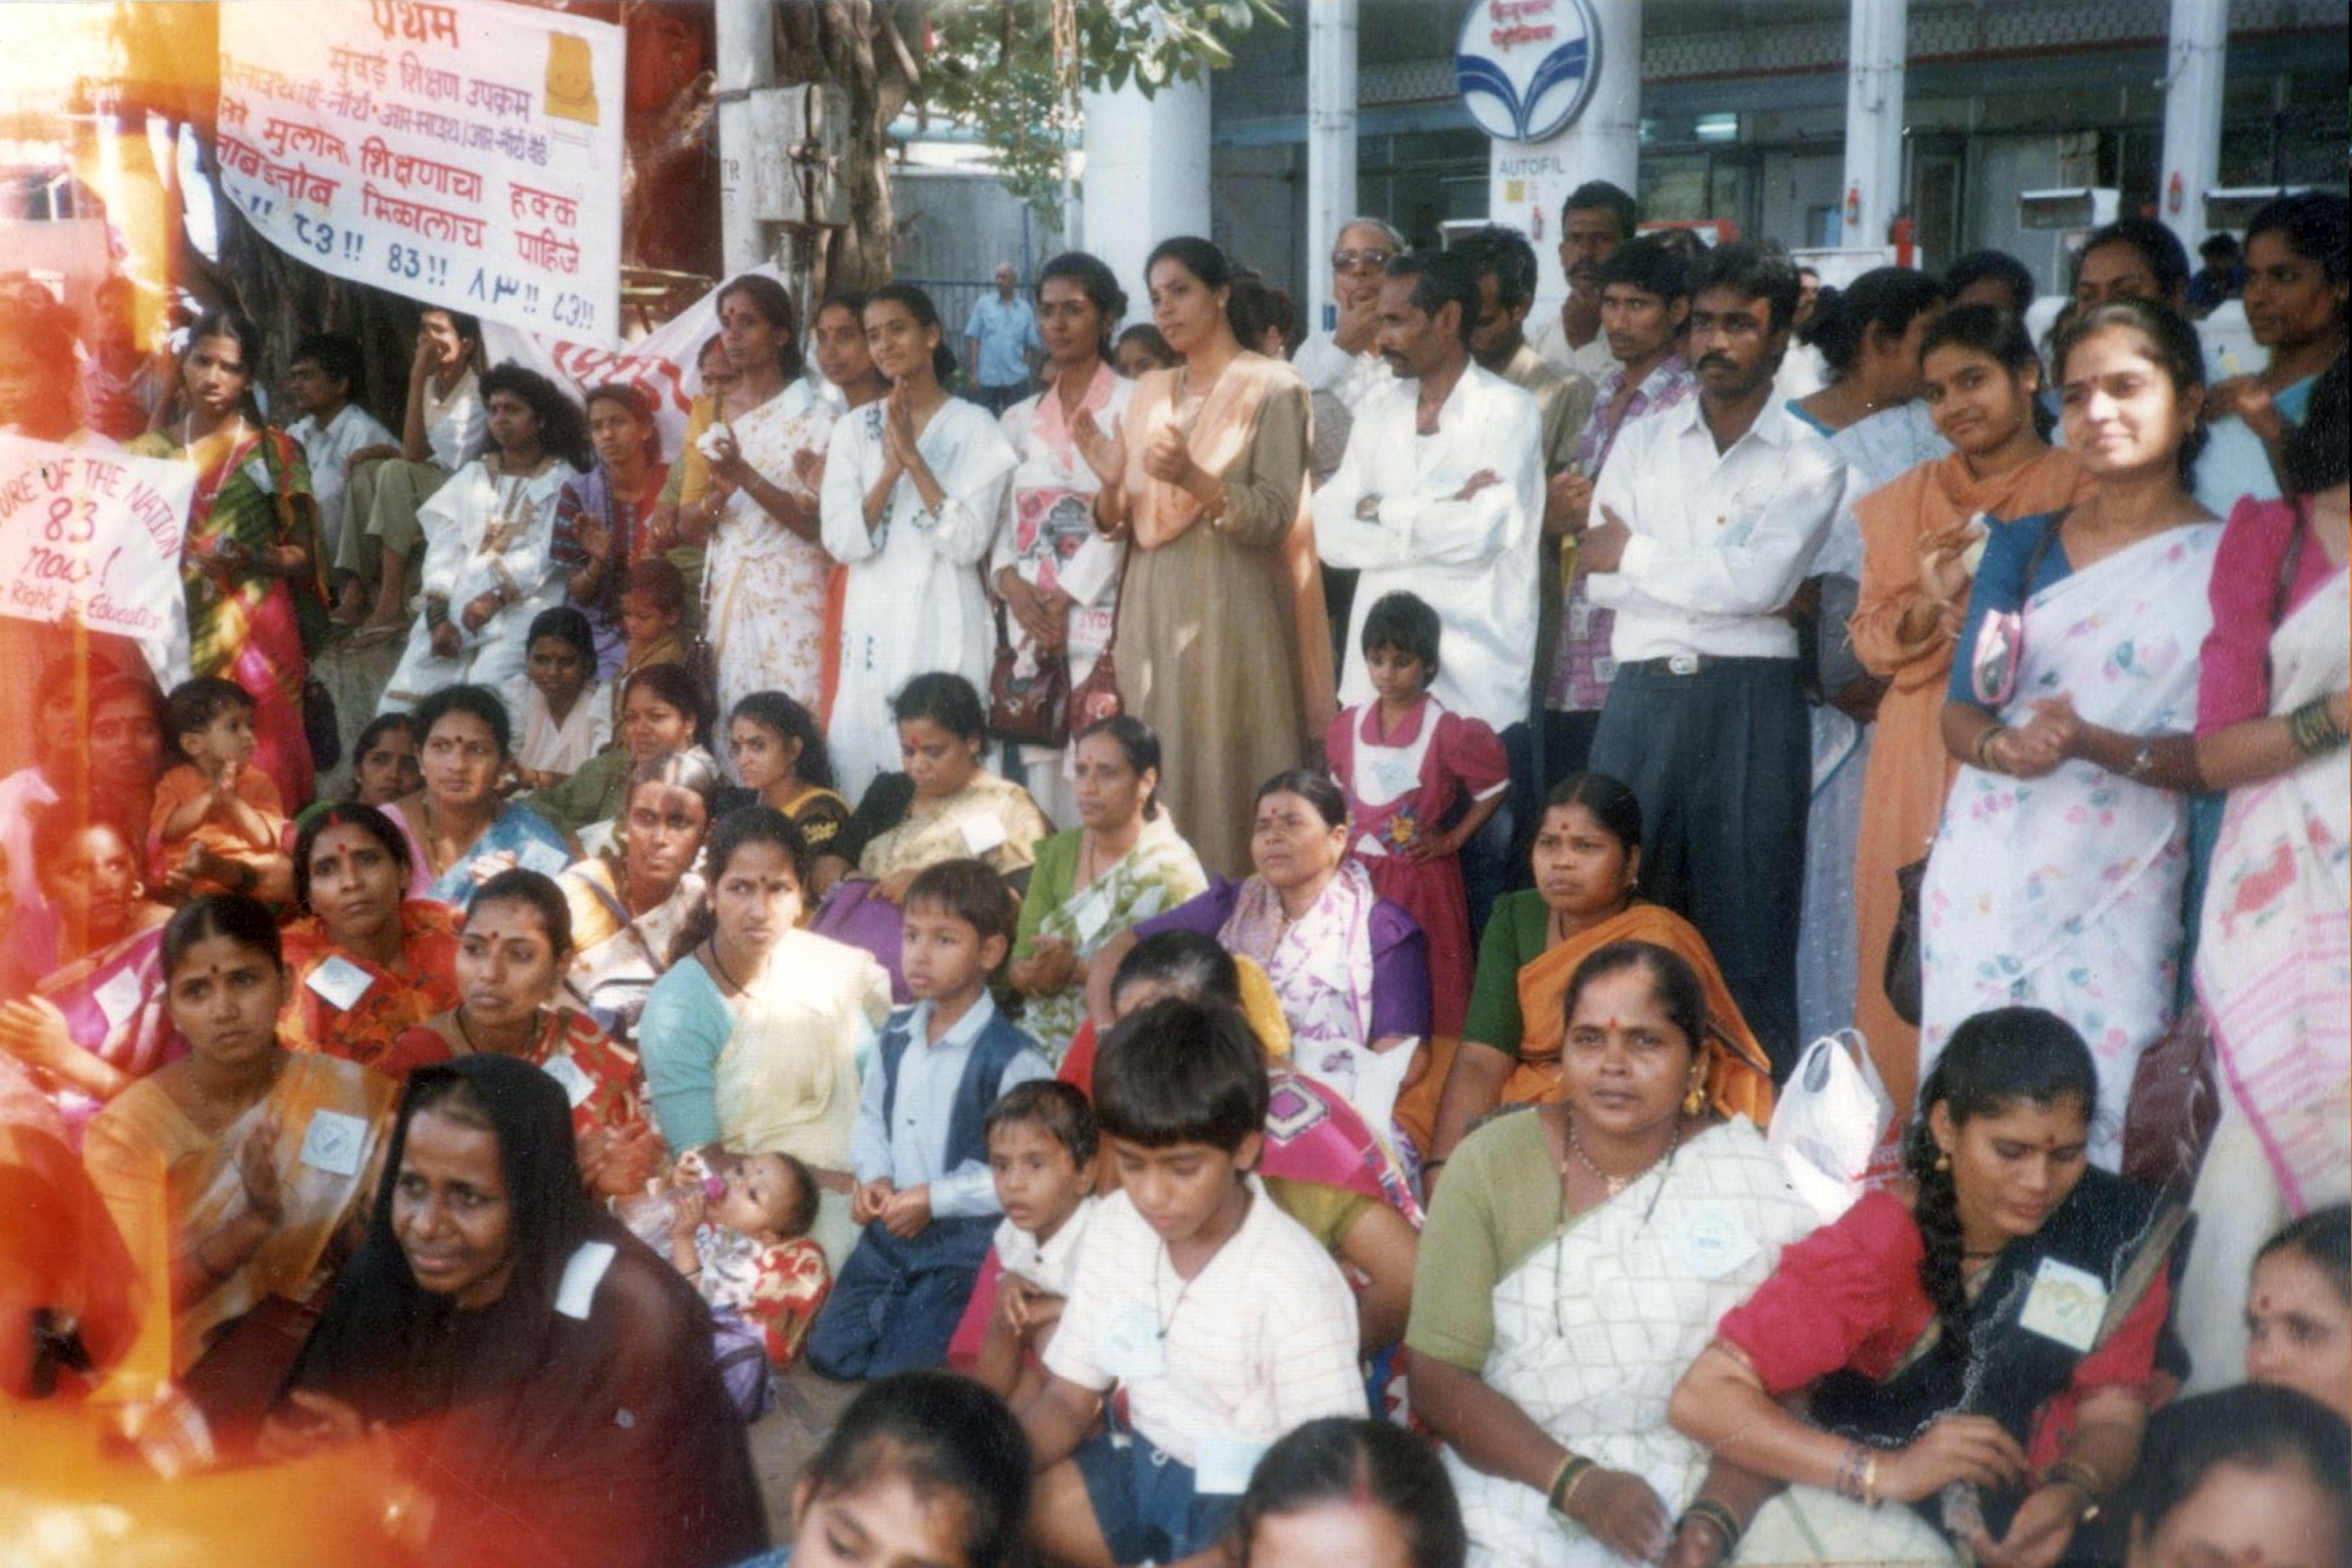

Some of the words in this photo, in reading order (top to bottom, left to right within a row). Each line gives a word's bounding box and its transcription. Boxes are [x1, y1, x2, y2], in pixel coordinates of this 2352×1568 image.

[398, 50, 460, 103] शिक्षण
[465, 76, 532, 123] उपक्रम
[360, 135, 482, 203] शिक्षणाचा
[509, 180, 578, 228] हक्क
[514, 226, 580, 274] पाहिजे
[0, 469, 39, 520] URE
[42, 458, 74, 493] OF
[85, 458, 127, 499] THE
[123, 480, 182, 561] NATION
[44, 496, 99, 543] 83
